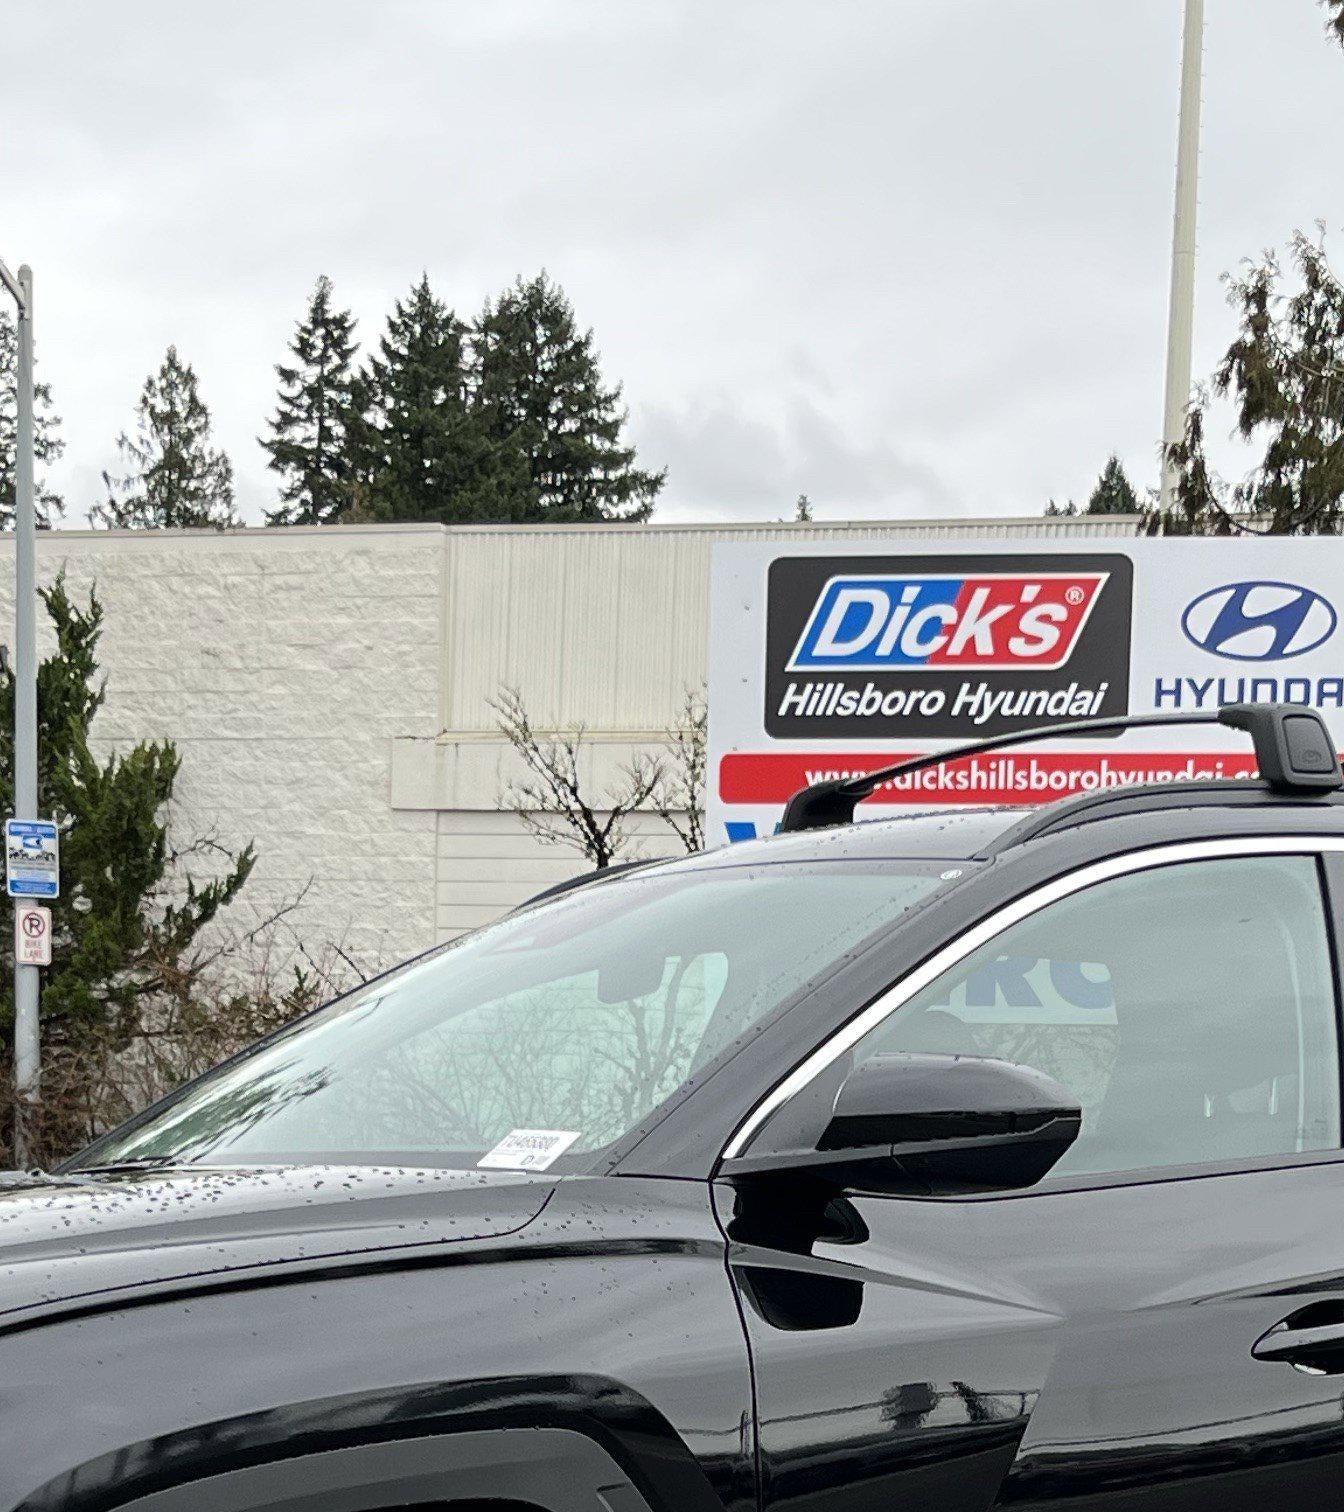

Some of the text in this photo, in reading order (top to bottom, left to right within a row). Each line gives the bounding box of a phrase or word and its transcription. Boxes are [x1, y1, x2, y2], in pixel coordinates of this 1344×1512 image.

[811, 585, 1068, 657] Dick's
[777, 682, 1109, 725] Hillsboro Hyundai
